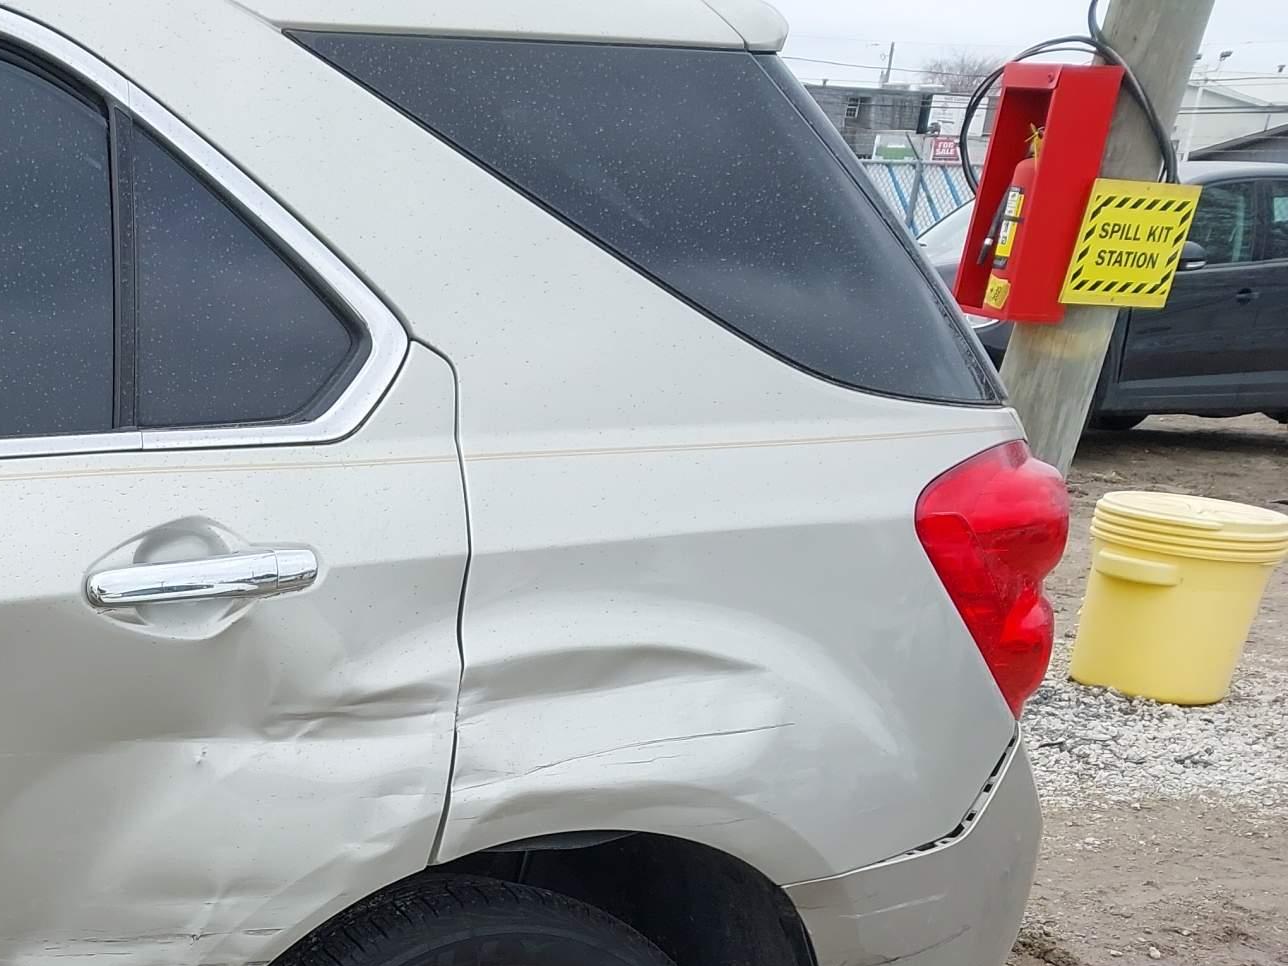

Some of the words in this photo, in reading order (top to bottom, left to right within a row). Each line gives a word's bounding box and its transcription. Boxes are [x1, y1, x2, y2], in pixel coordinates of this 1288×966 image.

[1099, 222, 1142, 241] SPILL
[1146, 225, 1174, 243] KIT
[1095, 249, 1159, 269] STATION
